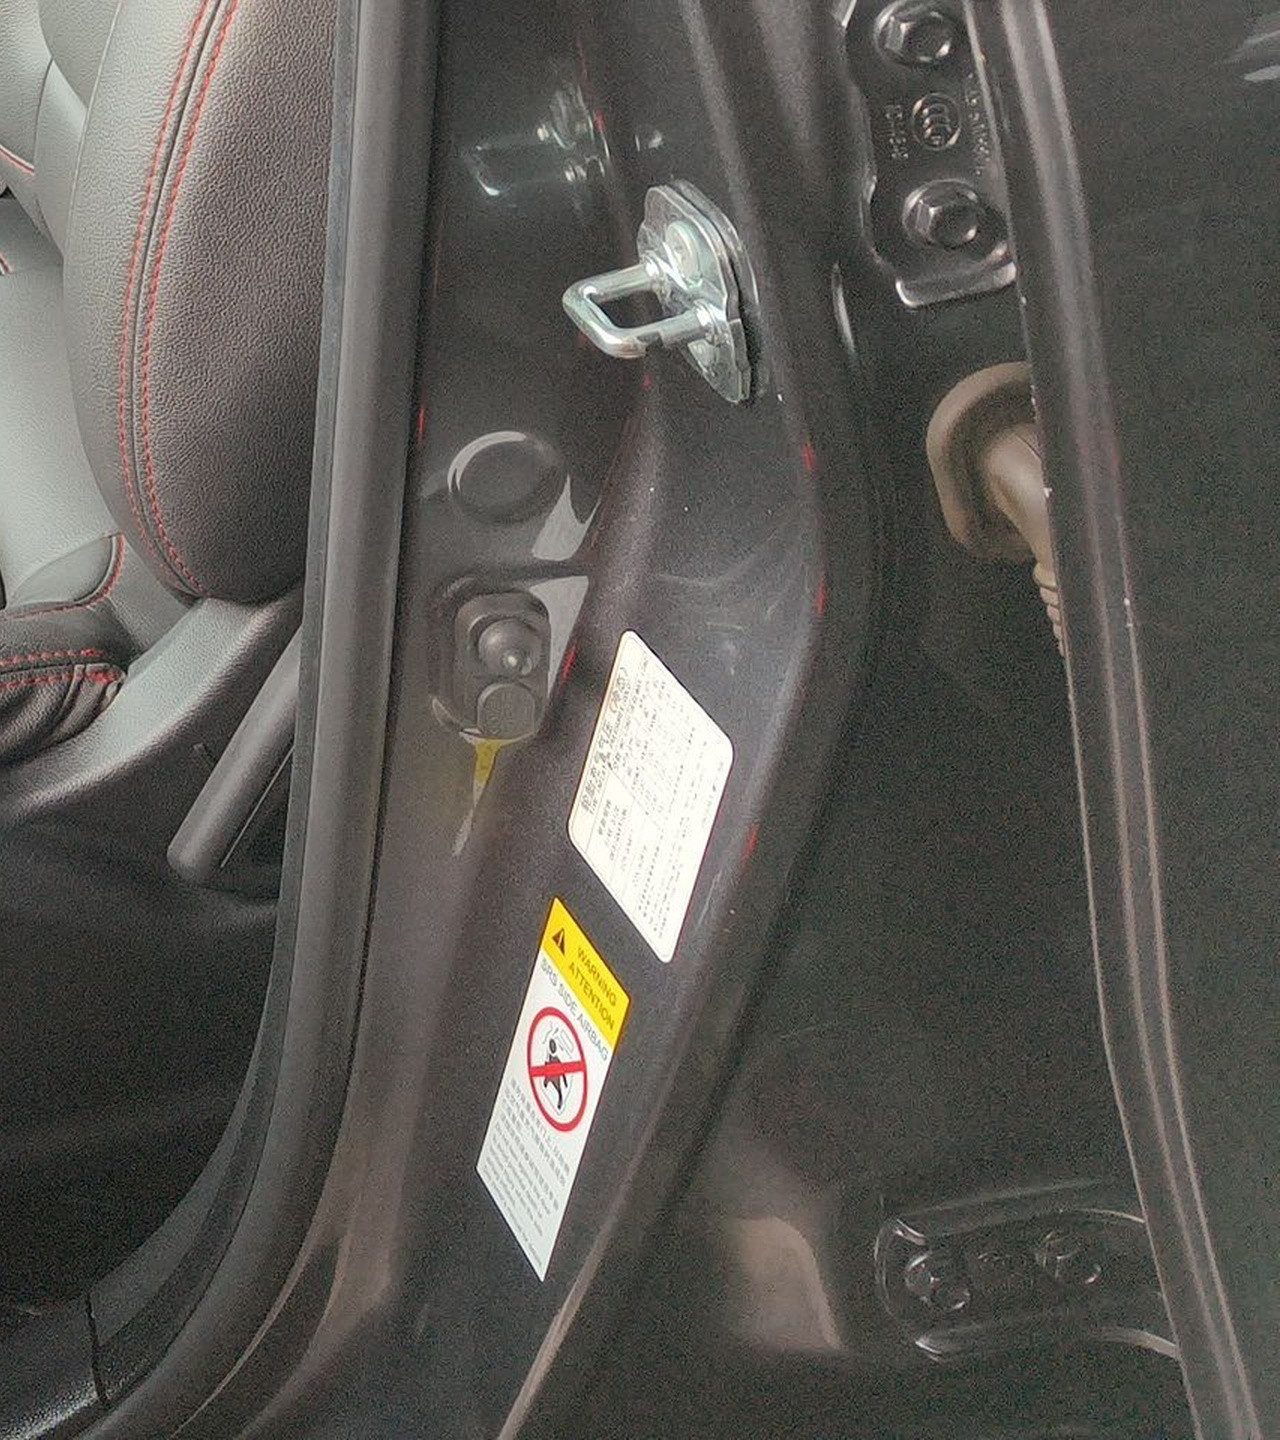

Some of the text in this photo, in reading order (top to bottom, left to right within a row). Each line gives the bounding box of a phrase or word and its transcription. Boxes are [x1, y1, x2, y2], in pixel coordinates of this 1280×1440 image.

[540, 958, 610, 1061] SRS SIDE AIRBAG
[568, 962, 616, 1031] ATTENTION
[577, 946, 618, 1007] WARNING
